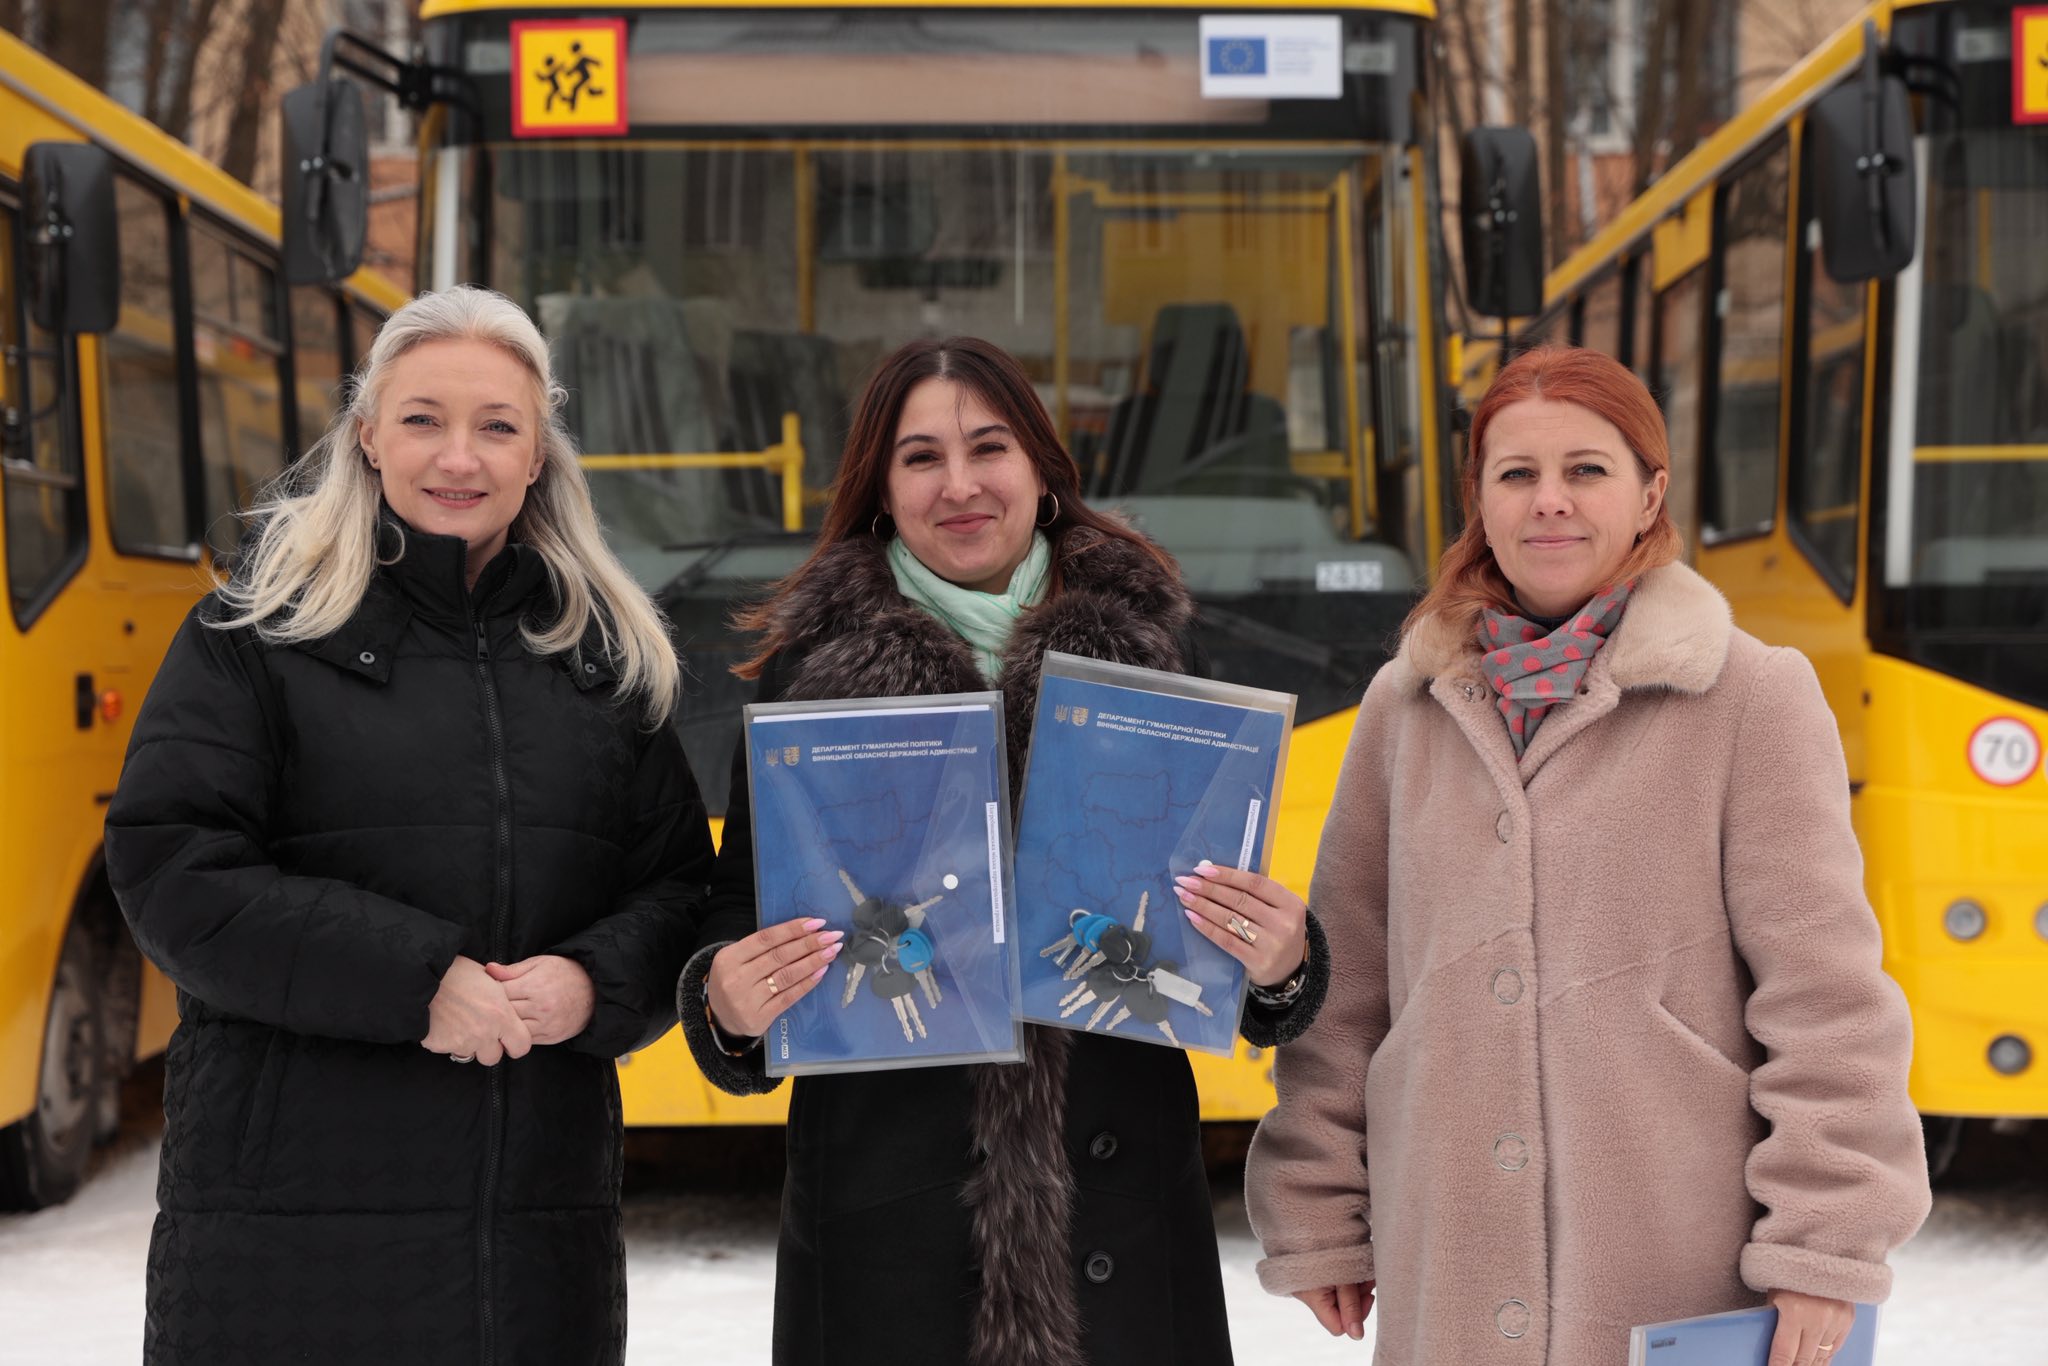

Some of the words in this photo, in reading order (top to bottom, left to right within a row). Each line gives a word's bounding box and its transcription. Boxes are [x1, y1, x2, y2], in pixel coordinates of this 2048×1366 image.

[1096, 720, 1137, 734] ВІННИЦЬКОЇ
[1137, 727, 1171, 740] ОБЛАСНОЇ
[1171, 733, 1211, 746] ДЕРЖАВНОЇ
[1211, 740, 1259, 753] АДМІНІСТРАЦІЇ
[1097, 712, 1146, 726] ДЕПАРТАМЕНТ
[1146, 720, 1194, 735] ГУМАНІТАРНОЇ
[1194, 728, 1227, 739] ПОЛІТИКИ
[811, 744, 860, 754] ДЕПАРТАМЕНТ
[861, 741, 909, 751] ГУМАНІТАРНОЇ
[909, 740, 943, 748] ПОЛІТИКИ
[812, 752, 853, 762] ВІННИЦЬКОЇ
[853, 751, 888, 760] ОБЛАСНОЇ
[889, 749, 928, 759] ДЕРЖАВНОЇ
[929, 747, 977, 757] АДМІНІСТРАЦІЇ
[1983, 734, 2029, 771] 70
